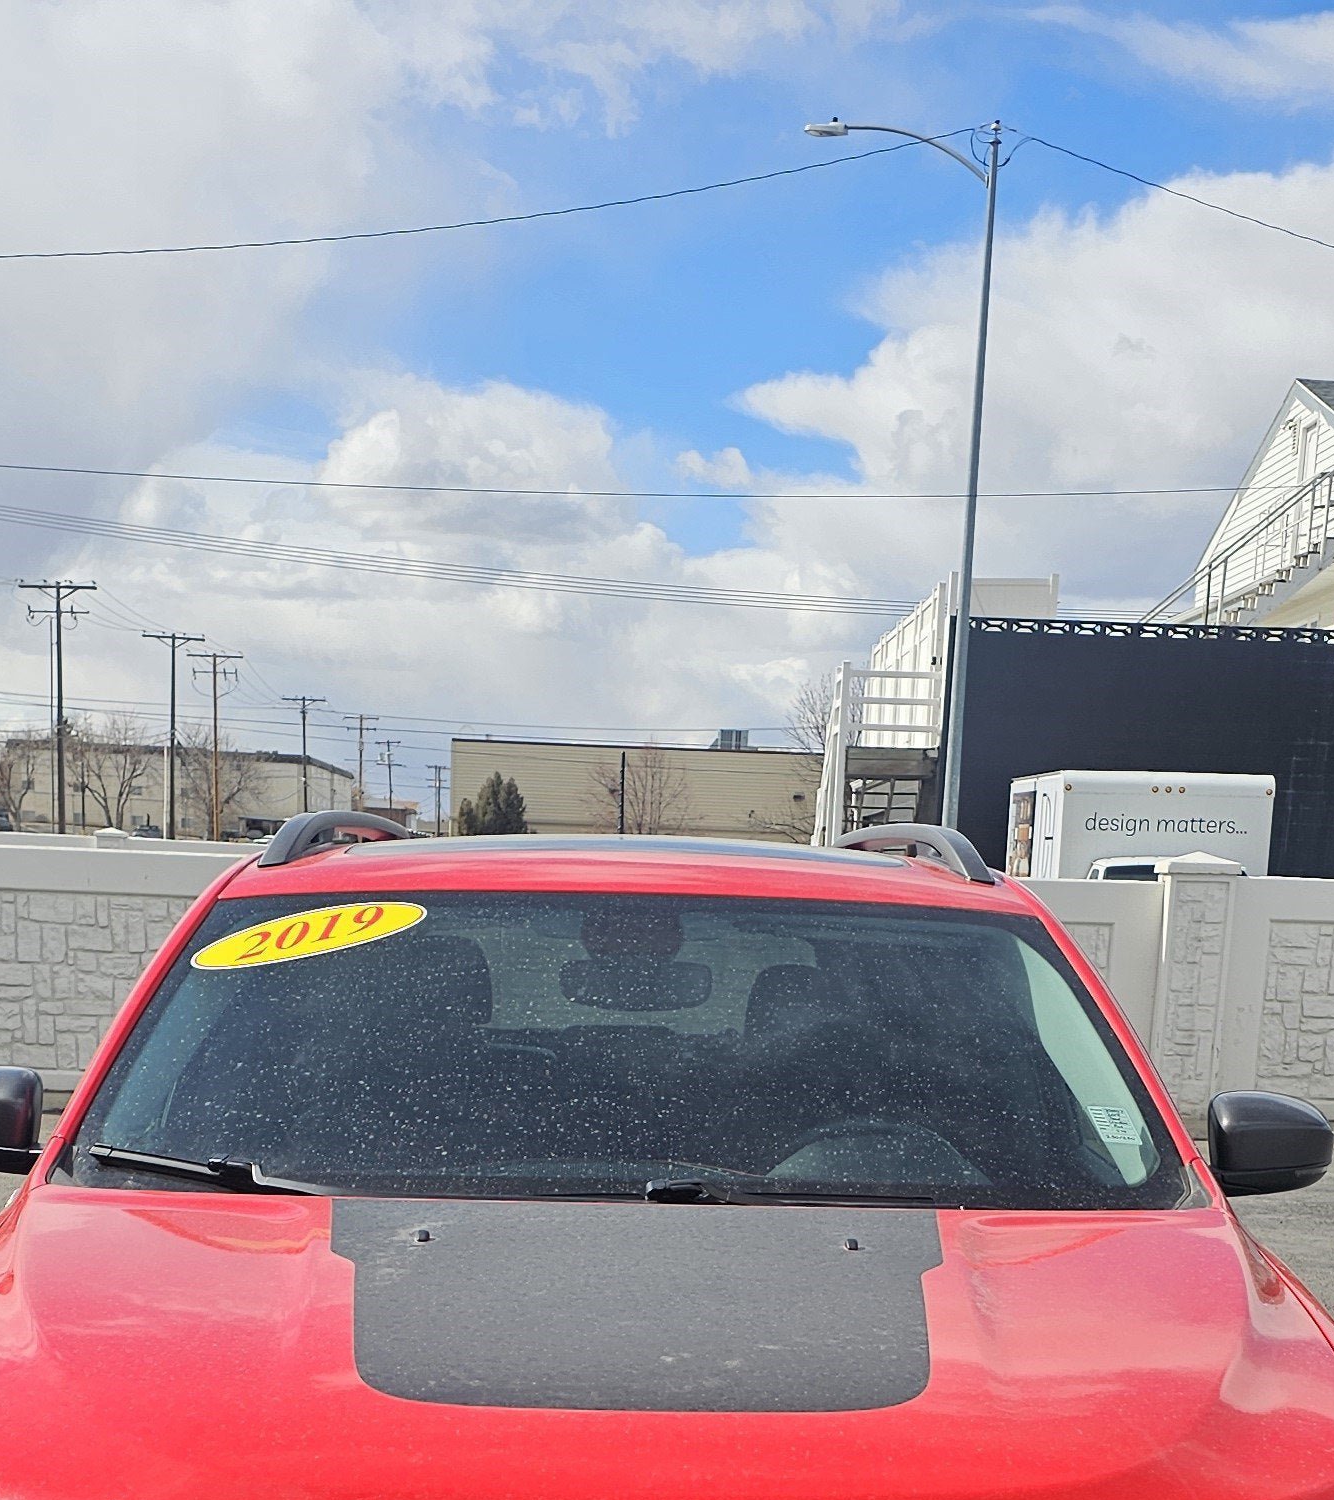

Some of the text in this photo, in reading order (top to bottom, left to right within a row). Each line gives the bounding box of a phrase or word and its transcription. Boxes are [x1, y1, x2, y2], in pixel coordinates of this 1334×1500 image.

[1085, 811, 1248, 837] design matters...
[234, 905, 385, 962] 2019
